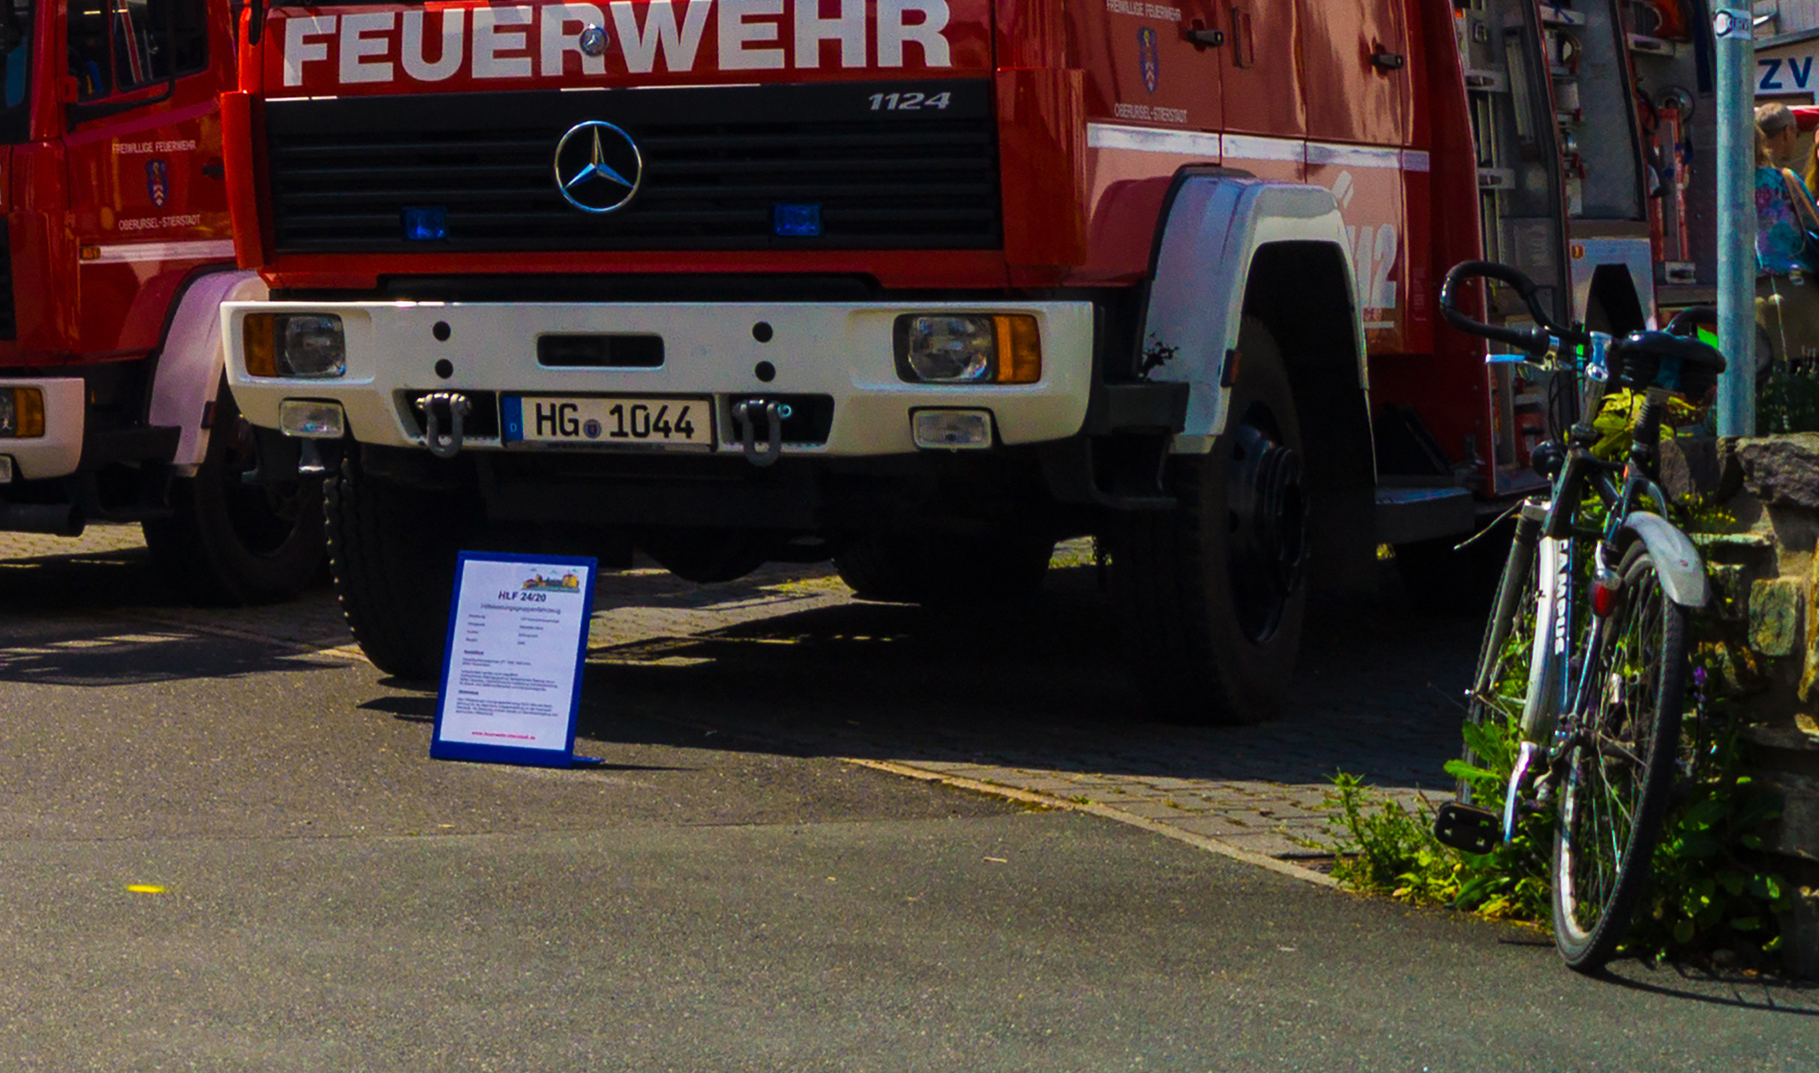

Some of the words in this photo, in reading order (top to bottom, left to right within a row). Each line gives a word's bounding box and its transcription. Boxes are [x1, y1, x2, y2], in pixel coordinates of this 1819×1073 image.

[867, 91, 951, 111] 1124
[535, 402, 580, 437] HG
[608, 403, 695, 440] 1044
[498, 589, 519, 601] HLF
